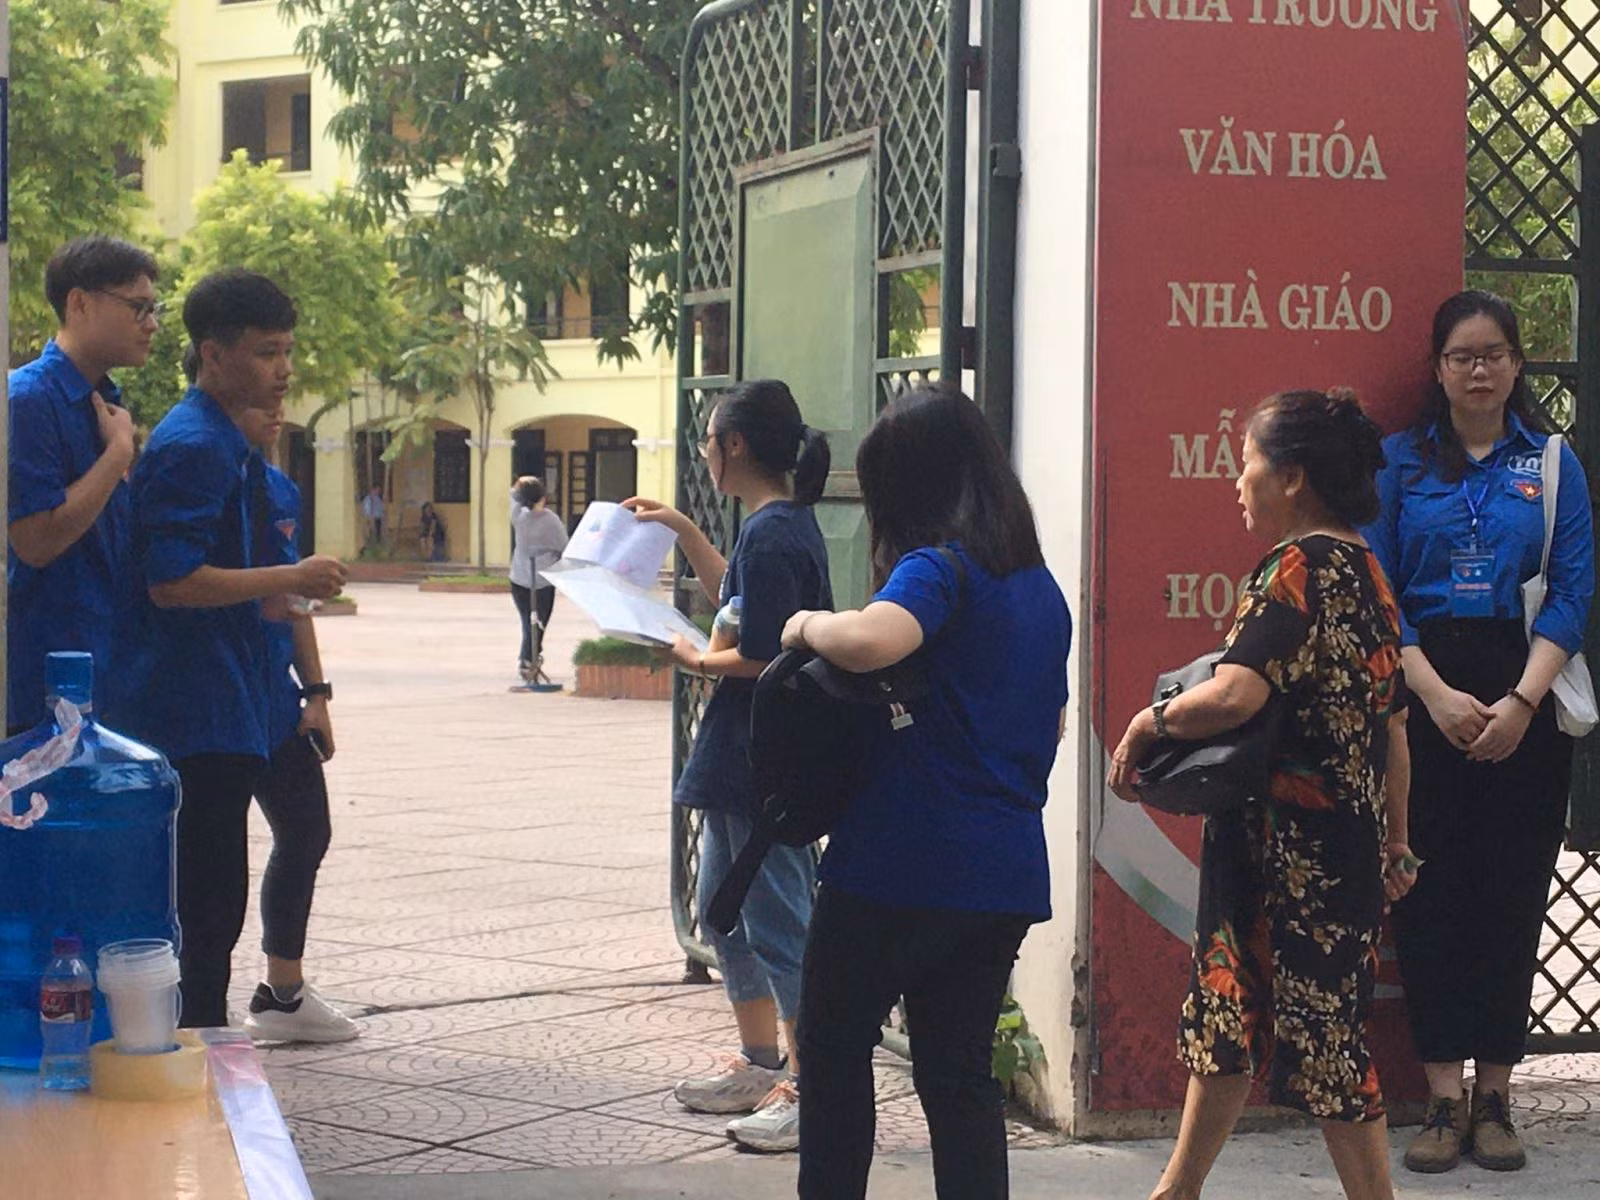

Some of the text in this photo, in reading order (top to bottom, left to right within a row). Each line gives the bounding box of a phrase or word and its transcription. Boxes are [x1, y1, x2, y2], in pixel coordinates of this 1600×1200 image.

[1179, 115, 1387, 180] VĂN HÓA
[1167, 268, 1393, 332] NHÀ GIÁO
[1169, 408, 1245, 479] MẪ
[1166, 572, 1252, 631] HỌ
